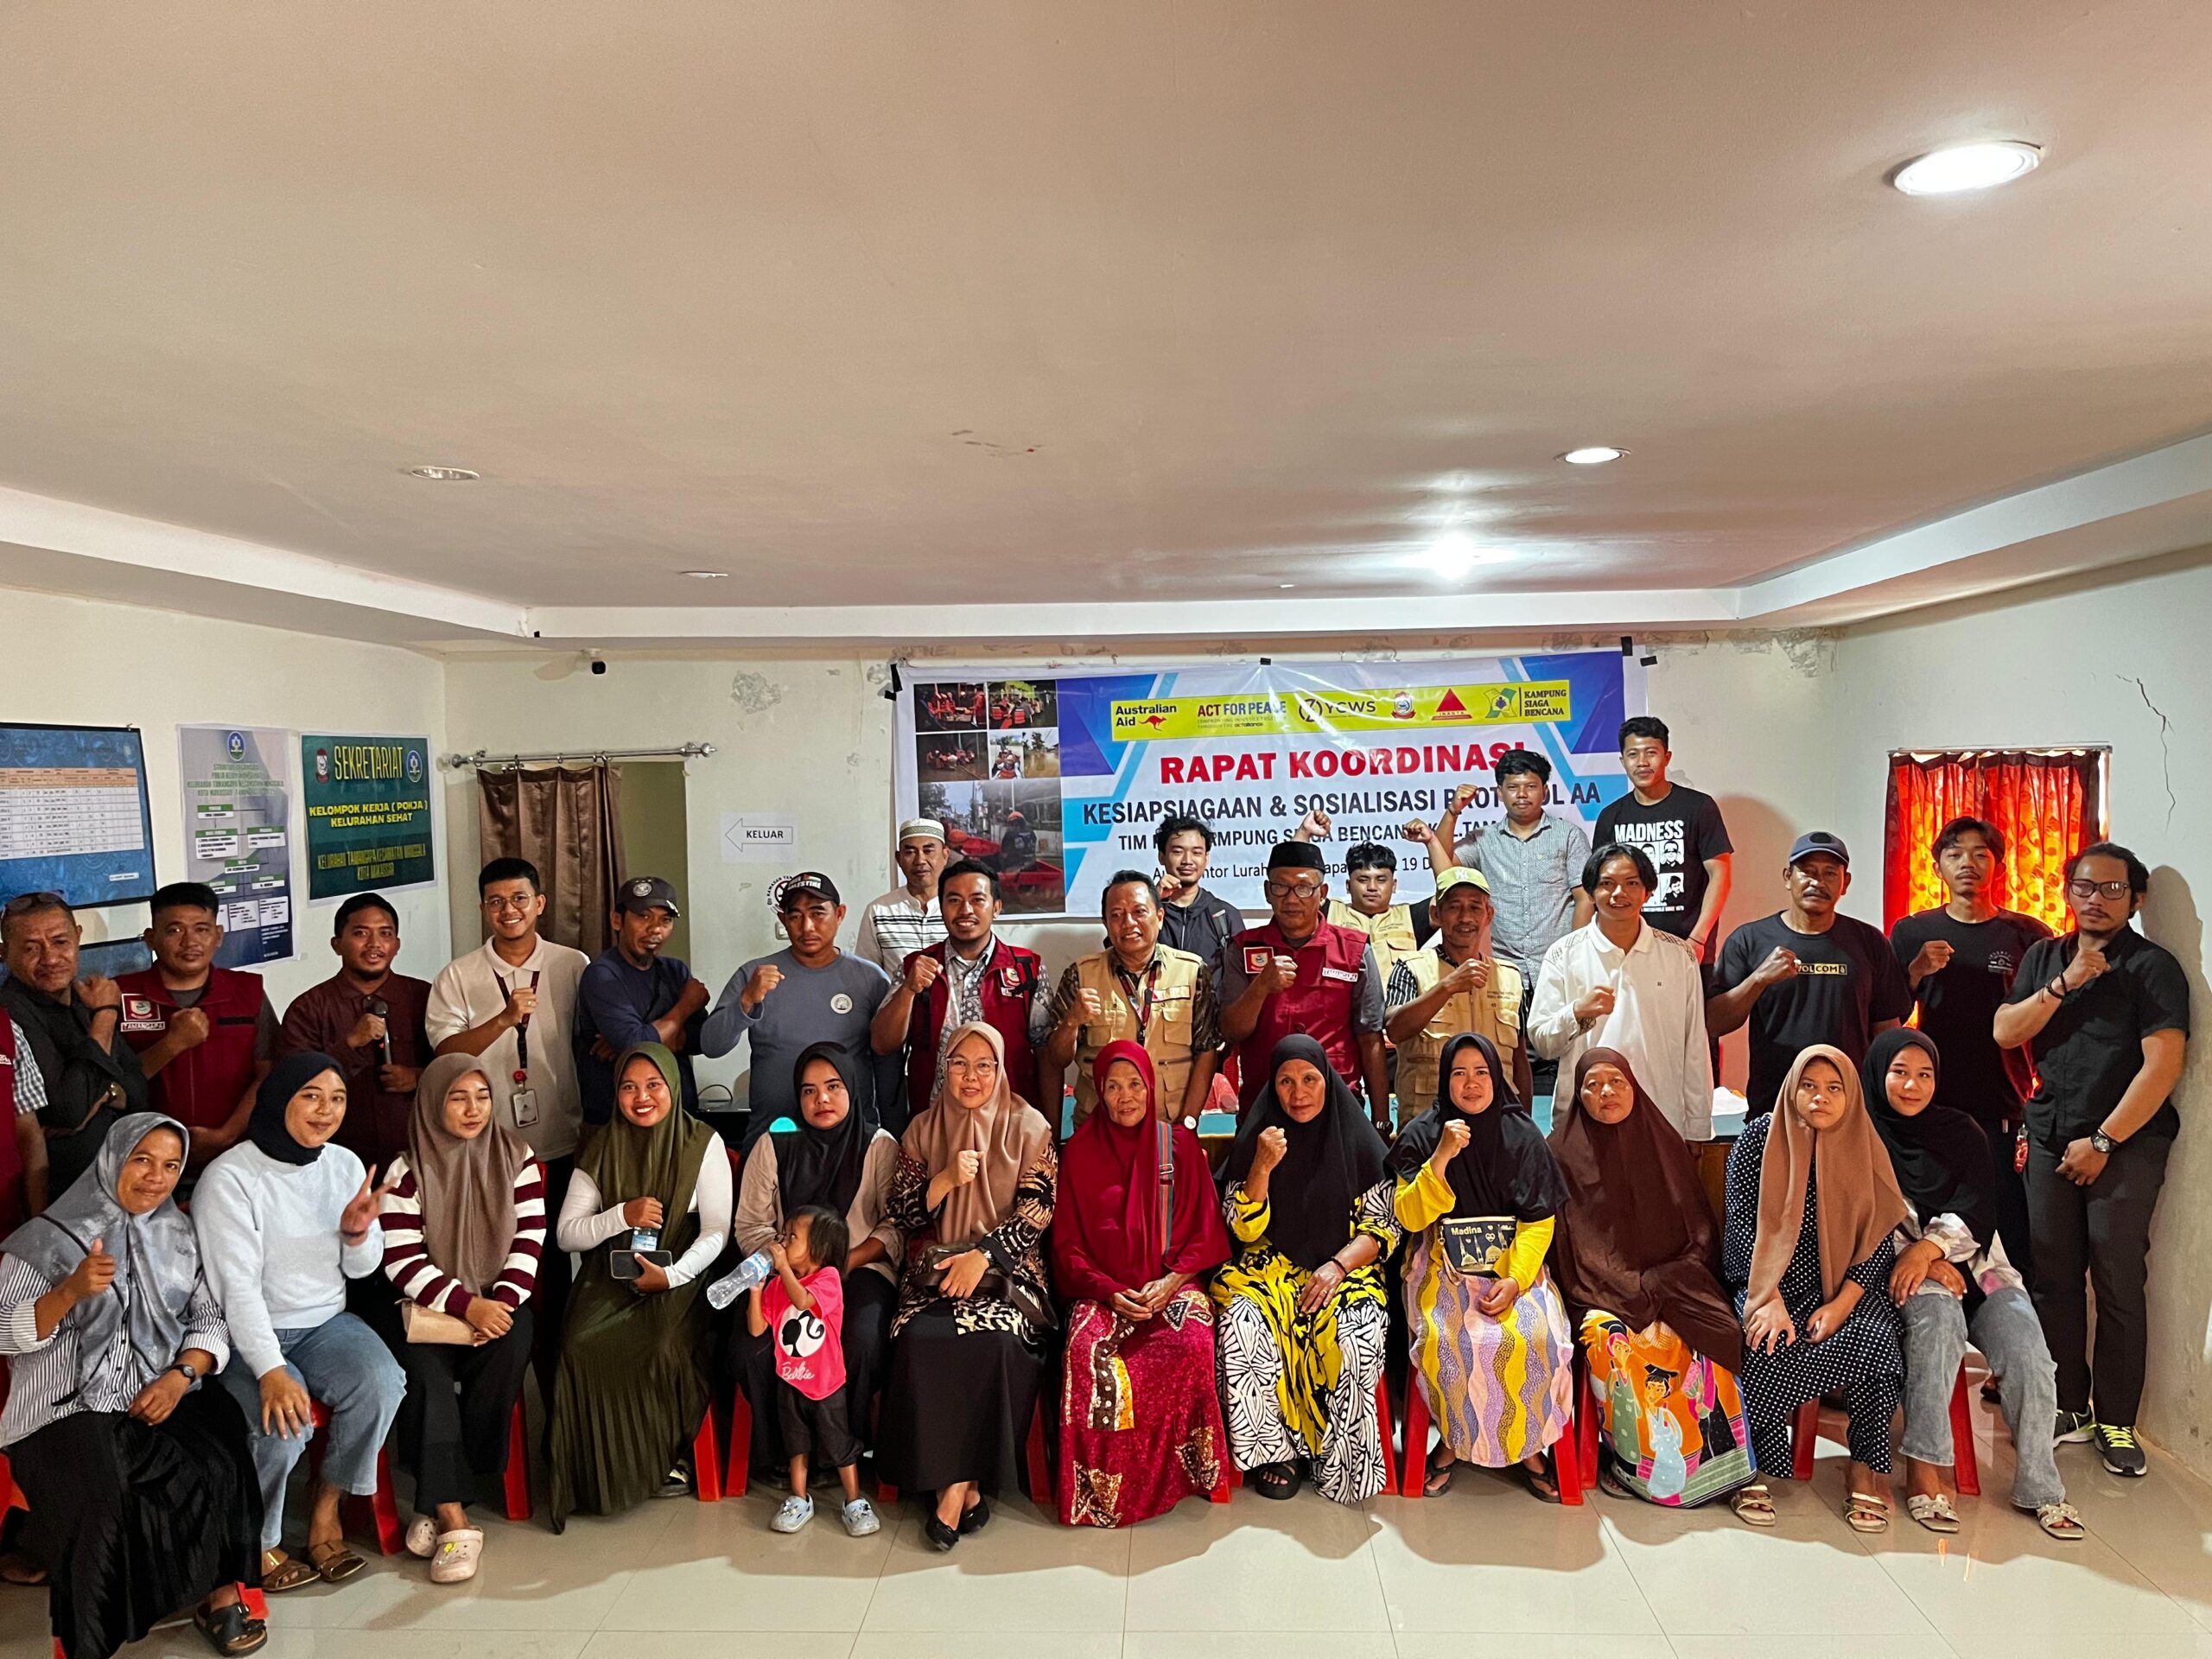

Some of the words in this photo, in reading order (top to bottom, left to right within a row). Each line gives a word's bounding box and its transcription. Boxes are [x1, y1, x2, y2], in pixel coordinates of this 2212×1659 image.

[1524, 689, 1567, 699] KAMPUNG
[1116, 703, 1177, 715] Australian
[1198, 704, 1221, 717] ACT
[1224, 702, 1246, 715] FOR
[1524, 699, 1549, 708] SIAGA
[1524, 708, 1565, 717] BENCANA
[1116, 716, 1136, 727] Aid
[334, 745, 404, 780] SEKRETARIAT
[1160, 753, 1276, 784] RAPAT
[1289, 741, 1524, 779] KOORDINAS
[1084, 796, 1262, 824] KESIAPSIAGAAN
[1269, 795, 1287, 817] &
[1294, 787, 1436, 817] SOSIALISASI
[1570, 782, 1601, 804] AA
[308, 804, 360, 817] KELOMPOK
[362, 804, 390, 814] KERJA
[331, 816, 385, 828] KELURAHAN
[386, 812, 413, 823] SEHAT
[746, 830, 784, 839] KELUAR
[1118, 835, 1147, 851] TIM
[1338, 823, 1405, 842] BENCAN
[1614, 820, 1684, 843] MADNESS
[1402, 857, 1418, 871] 19
[1451, 1226, 1483, 1236] Madina
